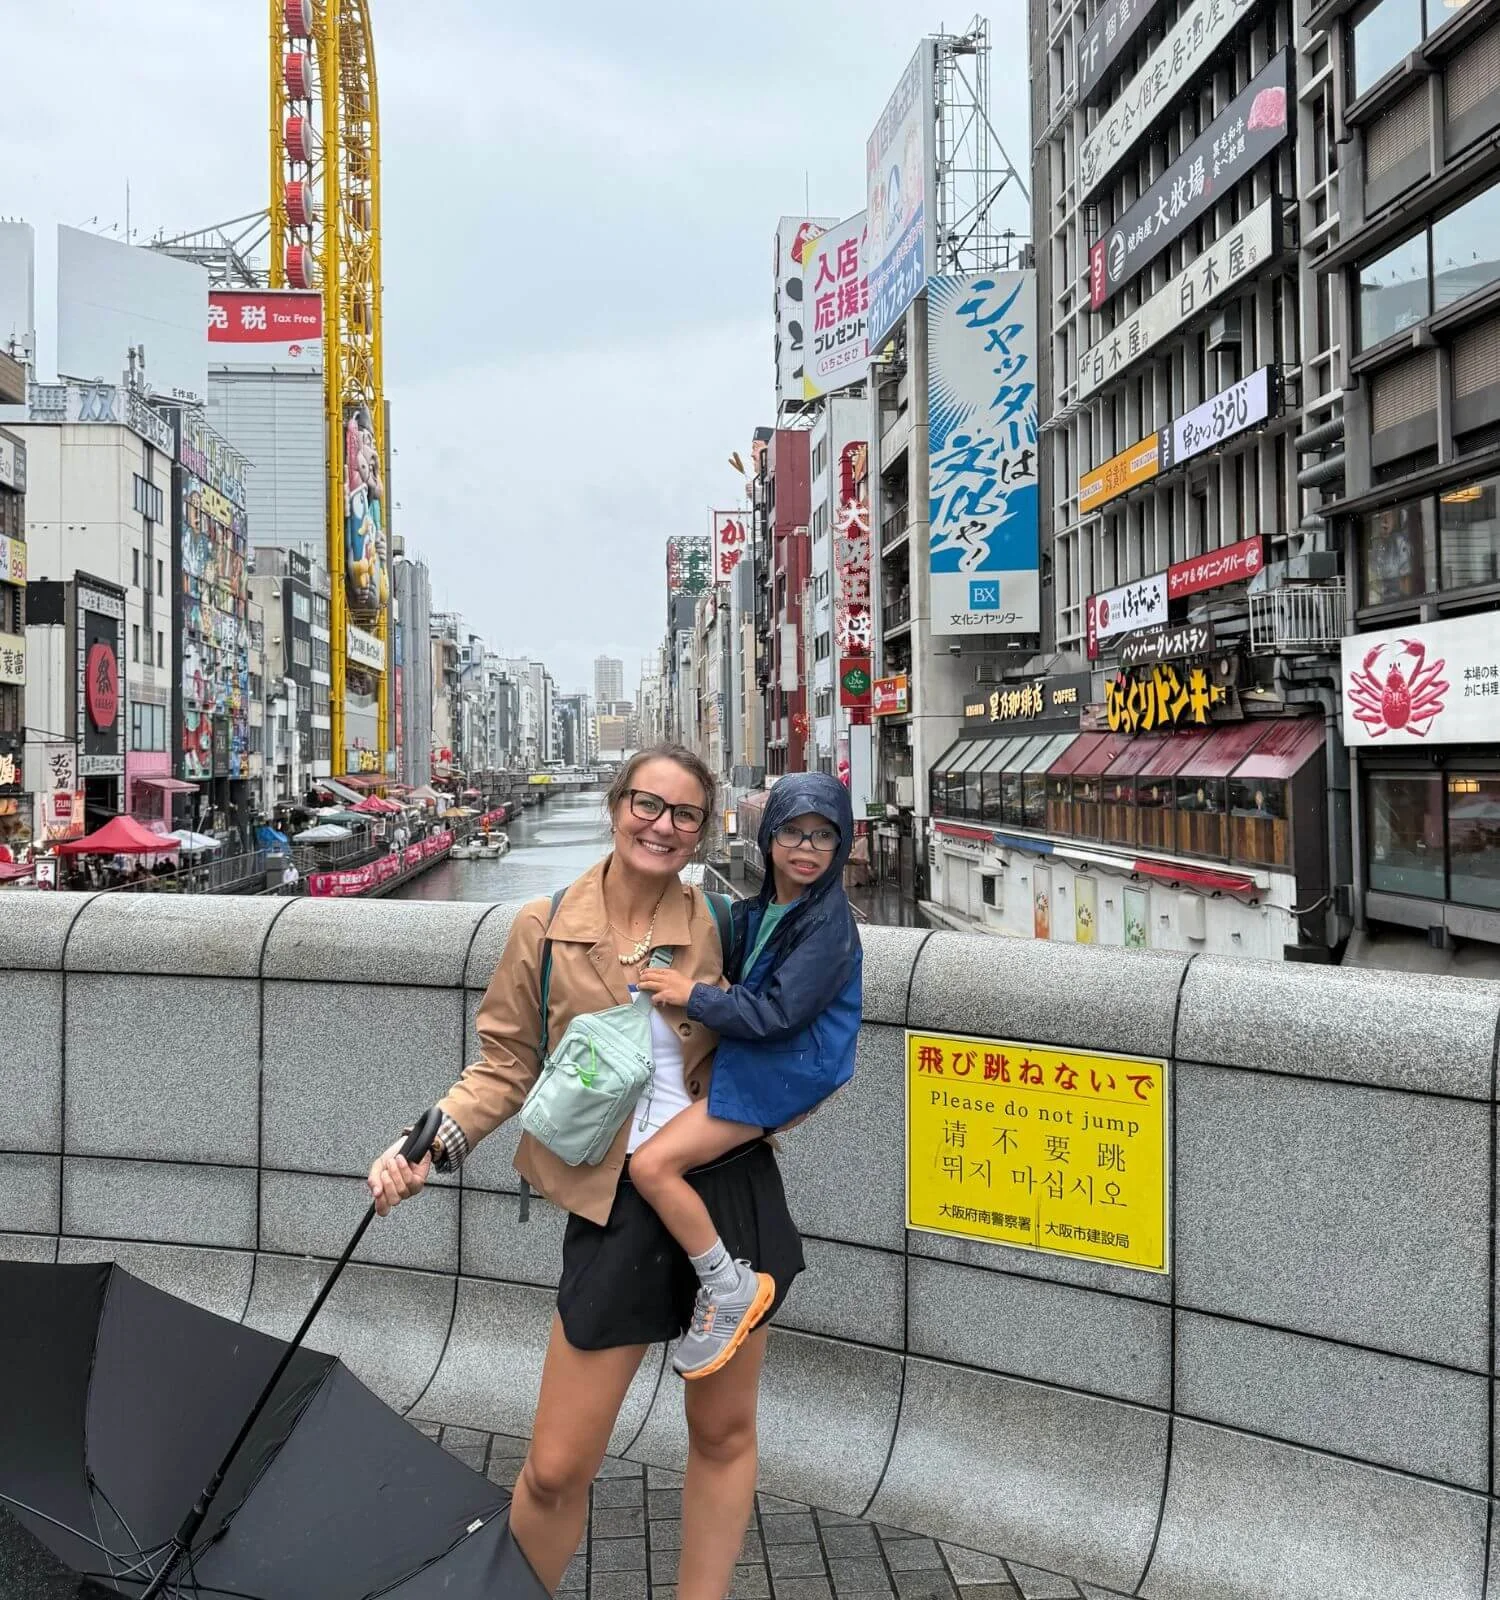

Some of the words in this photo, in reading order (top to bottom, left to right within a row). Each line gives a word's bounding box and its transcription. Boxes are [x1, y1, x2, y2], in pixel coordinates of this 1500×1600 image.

[1081, 31, 1099, 84] 7F
[1154, 154, 1206, 236] 大牧場
[814, 224, 868, 293] 入店
[1093, 247, 1103, 302] 5F
[1180, 232, 1246, 318] 白木屋
[208, 304, 268, 331] 免税
[272, 313, 292, 324] Tax
[294, 313, 317, 324] Free
[813, 316, 868, 355] プレゼント
[1081, 353, 1091, 377] 4F
[1093, 319, 1142, 387] 白木屋
[1162, 428, 1170, 467] 3F
[973, 587, 995, 603] BX
[1089, 608, 1096, 651] 2F
[1122, 627, 1208, 661] ハンバーグレストラン
[1463, 664, 1499, 681] 本場の味
[1463, 681, 1500, 697] かに料理
[989, 681, 1043, 722] 星乃珈琲店
[1052, 687, 1077, 705] COFFEE
[1104, 663, 1227, 734] びっくりドンキー
[917, 1045, 1155, 1101] 飛び跳ねないで
[931, 1090, 995, 1114] Please
[1004, 1099, 1029, 1118] do
[1038, 1108, 1074, 1125] not
[1081, 1112, 1140, 1138] jump
[942, 1119, 1126, 1173] 请不要跳
[941, 1154, 992, 1189] 뛰지
[1011, 1165, 1128, 1208] 마십시오
